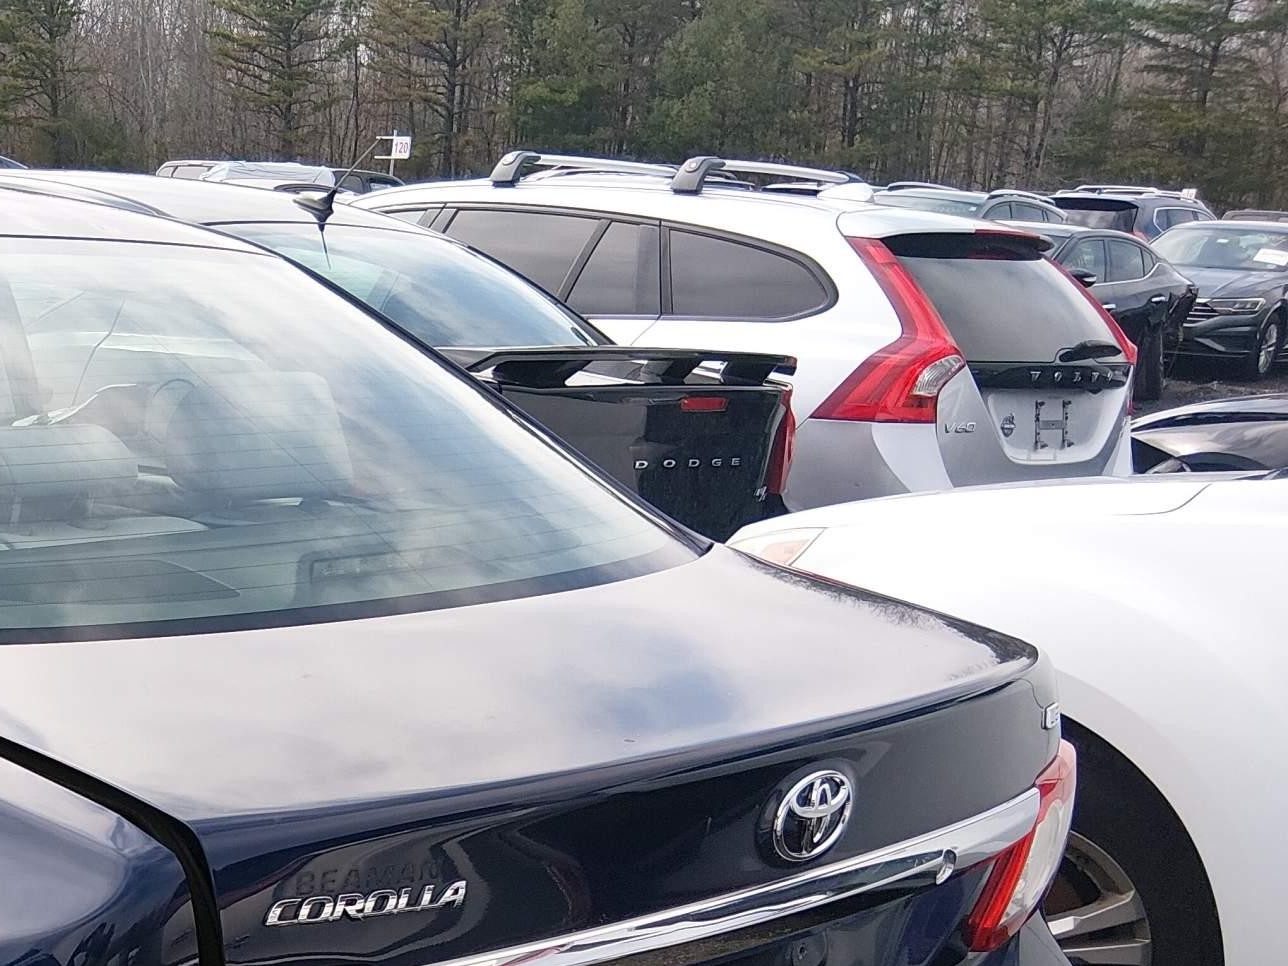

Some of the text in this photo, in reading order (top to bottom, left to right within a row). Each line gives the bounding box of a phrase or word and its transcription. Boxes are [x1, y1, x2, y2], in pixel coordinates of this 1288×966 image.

[394, 142, 409, 154] 120
[944, 422, 977, 434] V60
[634, 457, 741, 469] DODGE
[295, 863, 441, 898] BEAMAN
[264, 879, 467, 927] COROLLA
